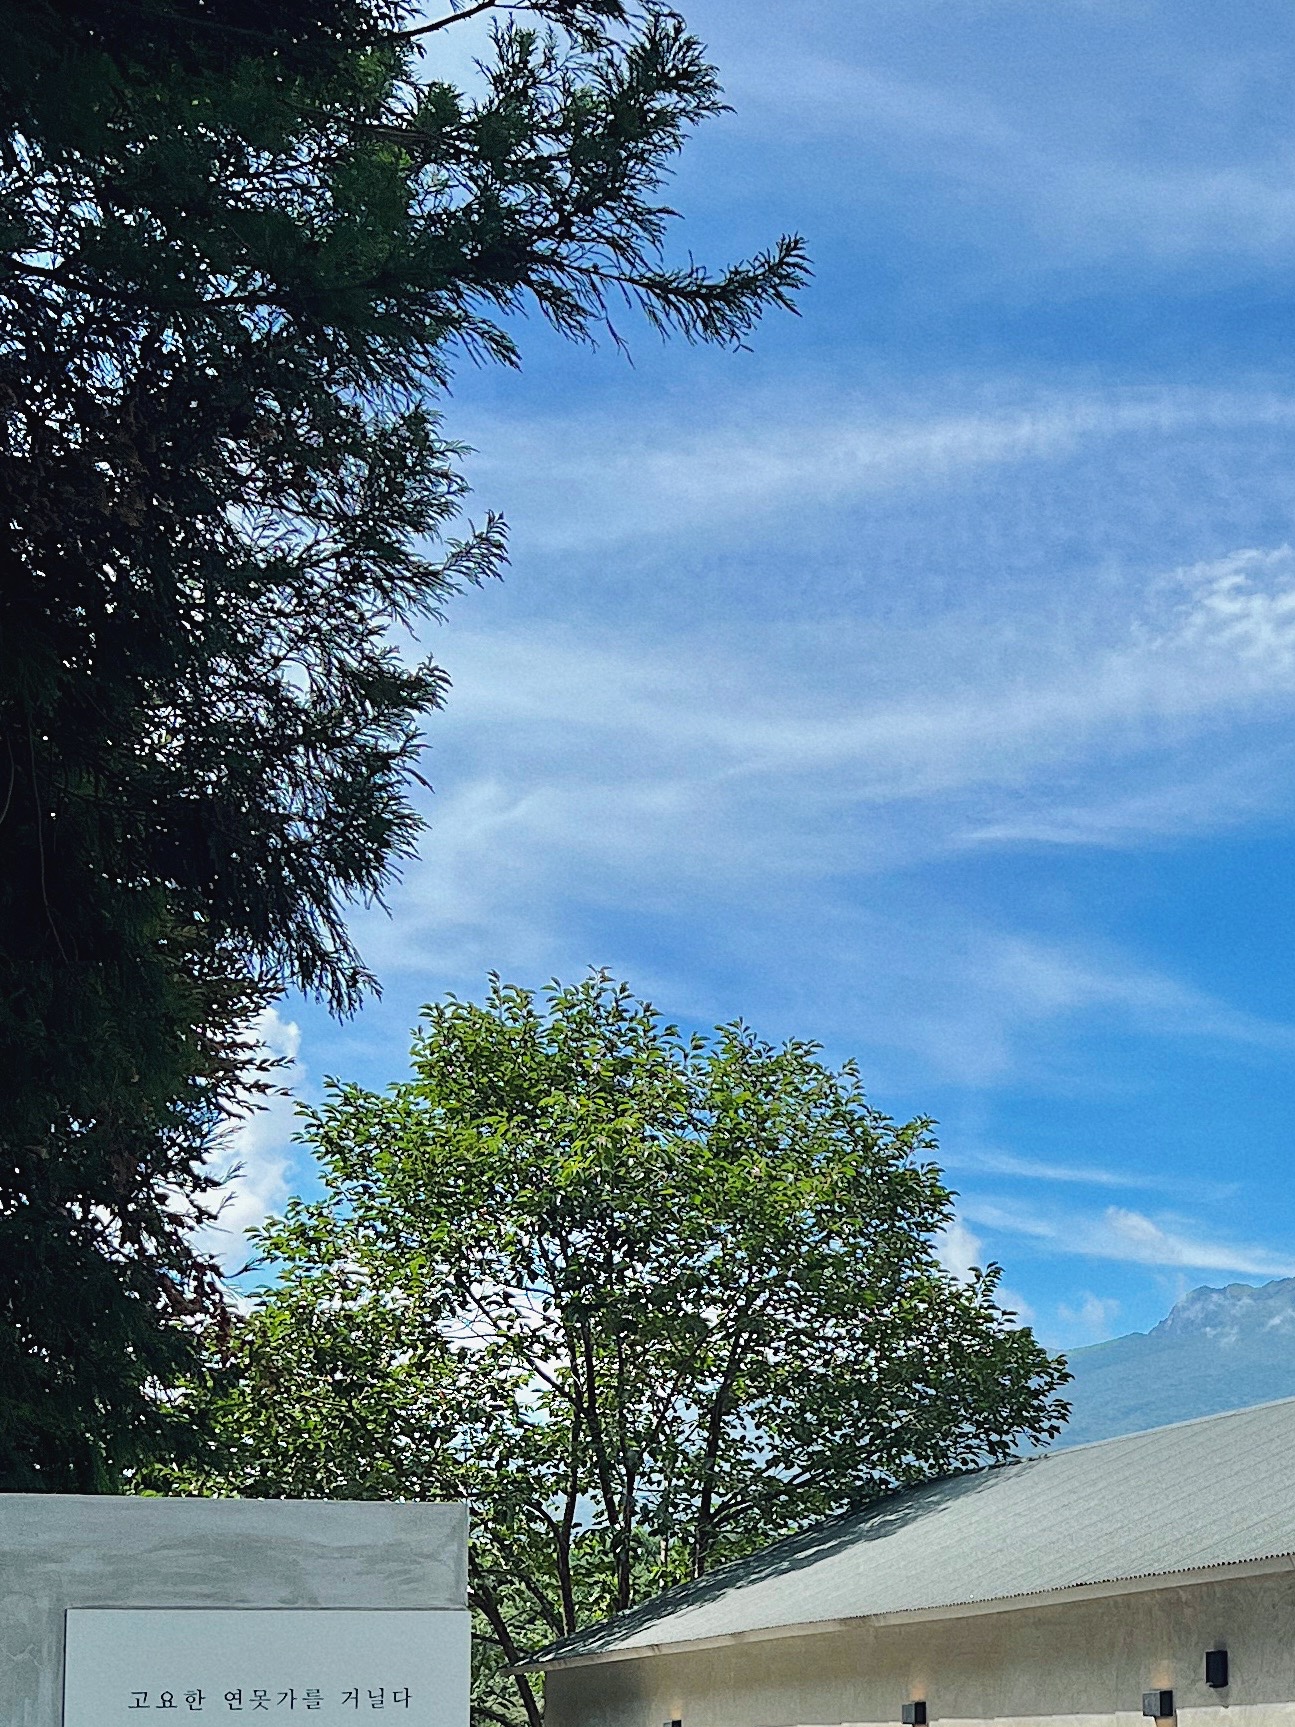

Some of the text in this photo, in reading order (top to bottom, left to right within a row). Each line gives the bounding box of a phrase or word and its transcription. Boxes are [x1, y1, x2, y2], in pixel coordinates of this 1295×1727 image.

[127, 1686, 413, 1711] 고요한 연못가를 거닐다
